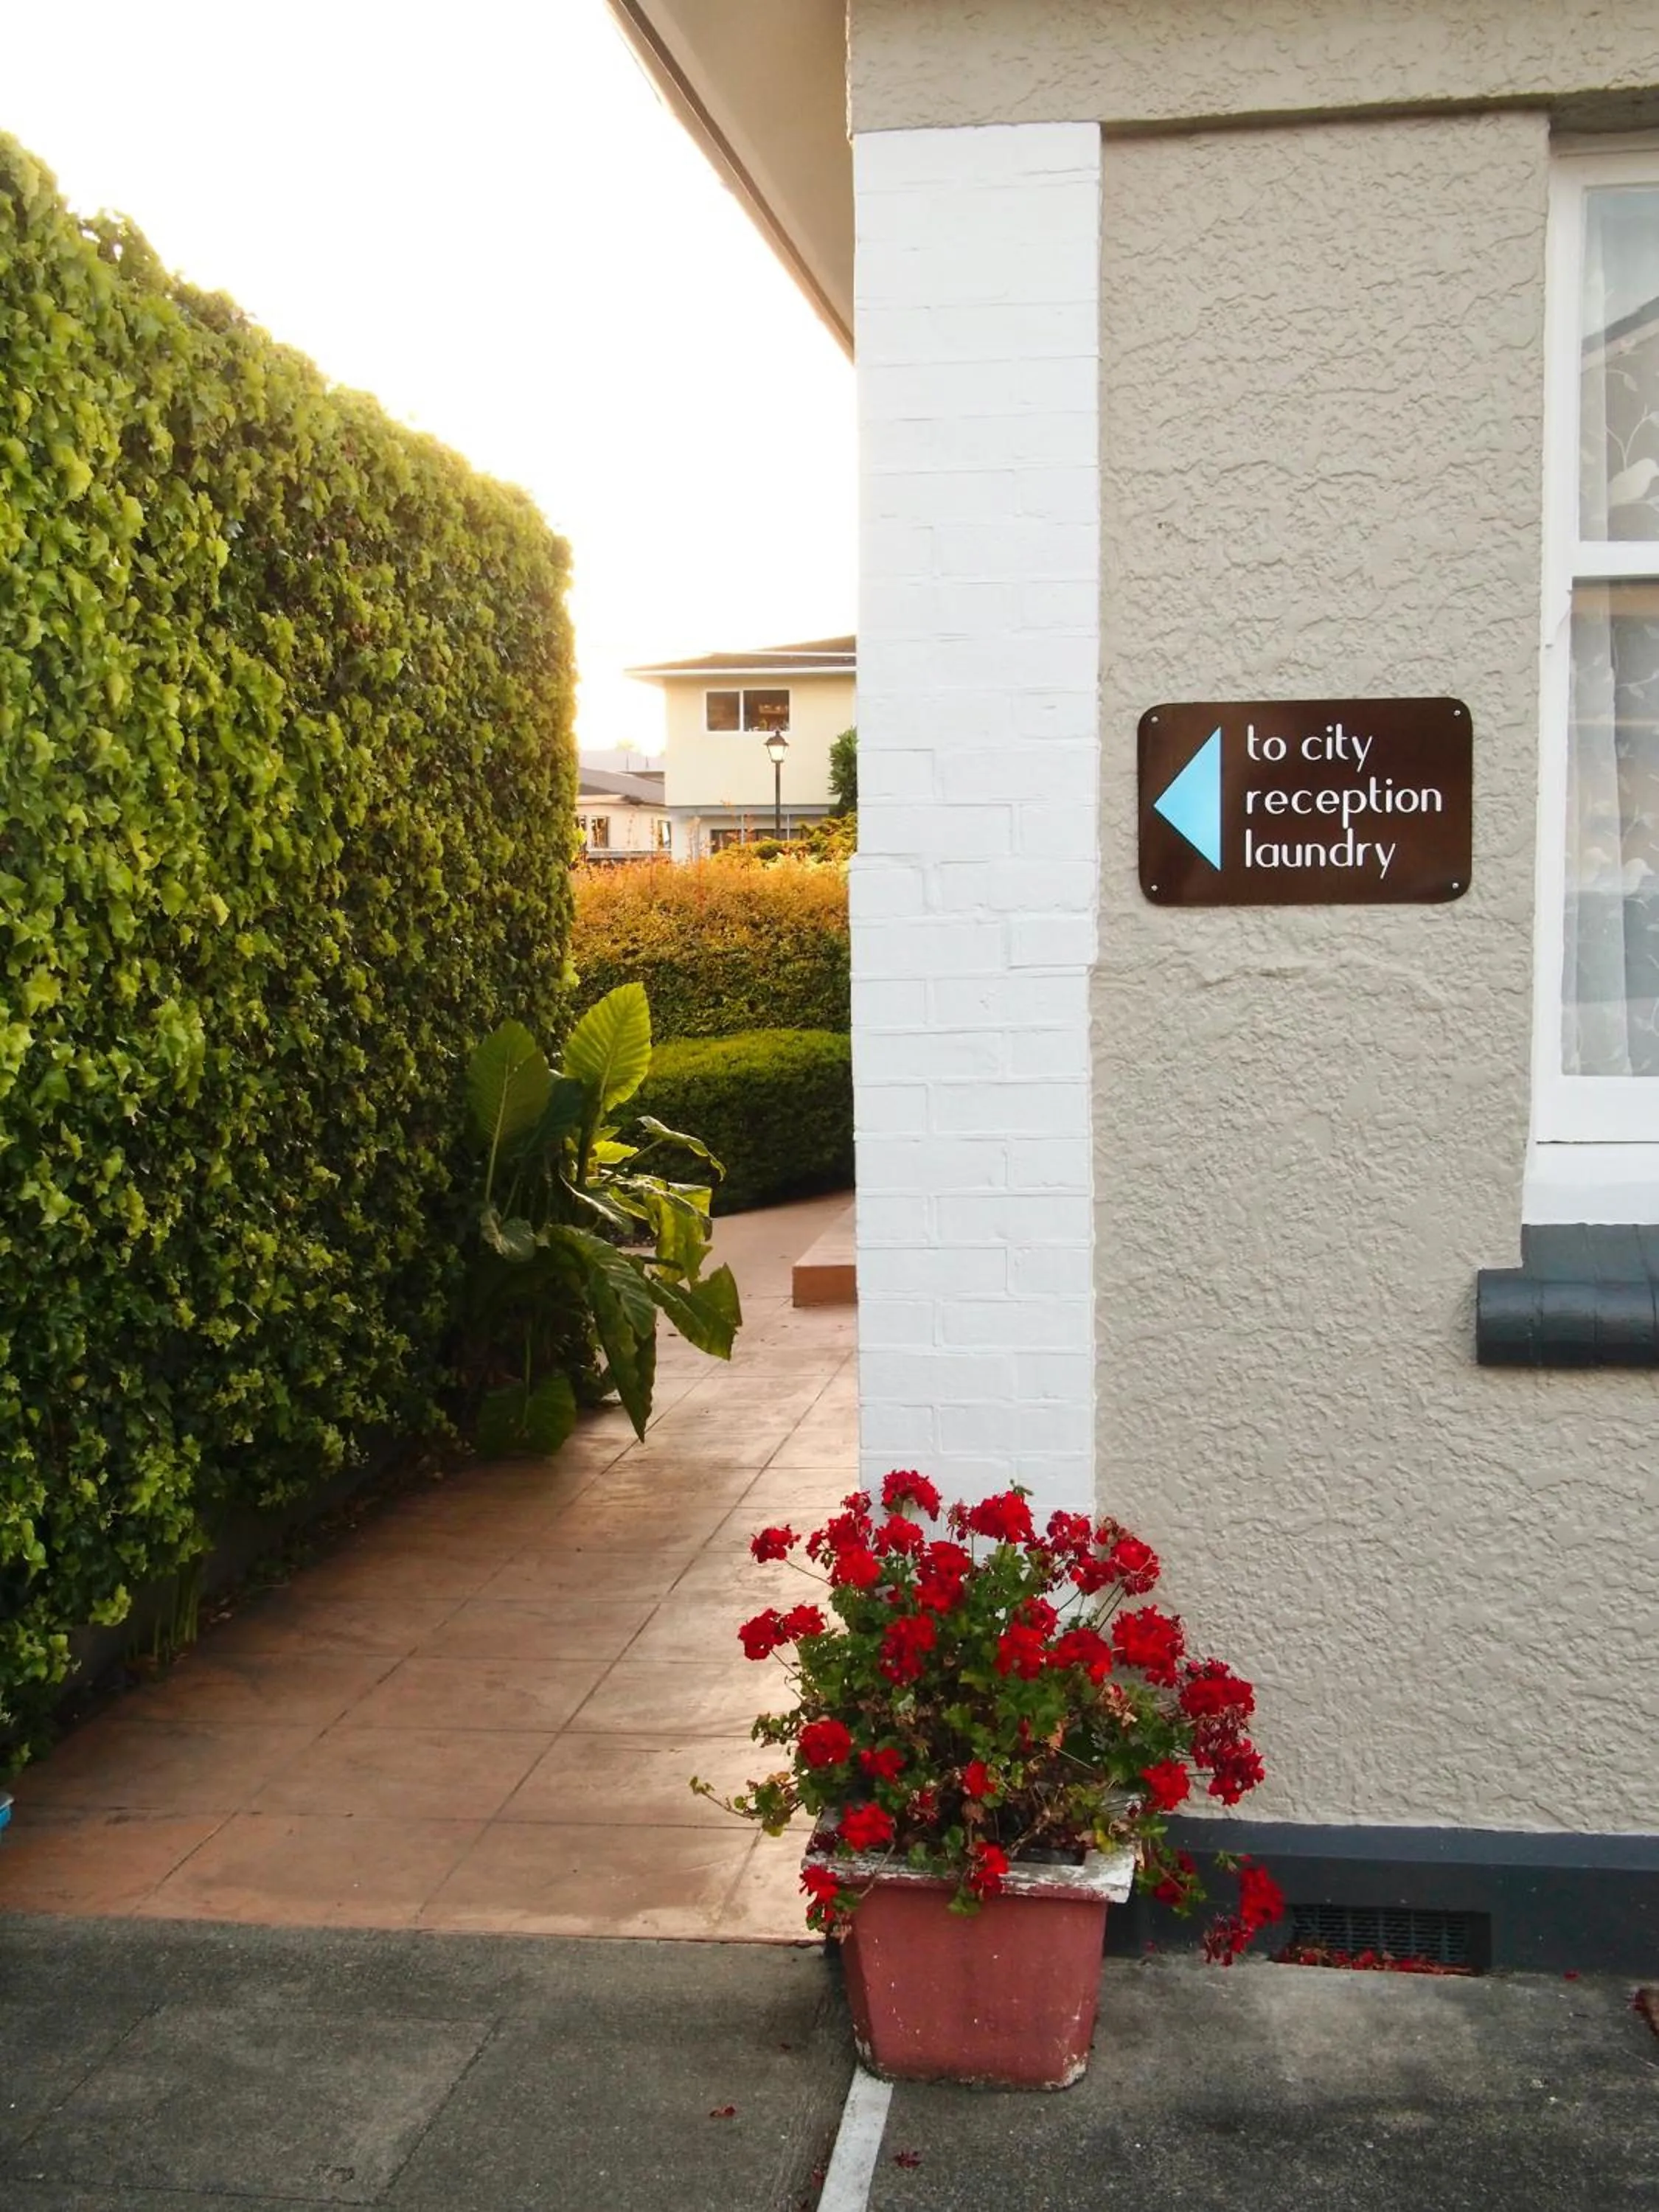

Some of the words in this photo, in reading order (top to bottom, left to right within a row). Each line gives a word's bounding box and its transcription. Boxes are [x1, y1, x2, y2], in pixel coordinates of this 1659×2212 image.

[1246, 723, 1287, 762] to
[1301, 723, 1373, 773] city
[1245, 776, 1443, 830] reception
[1245, 827, 1397, 880] laundry
